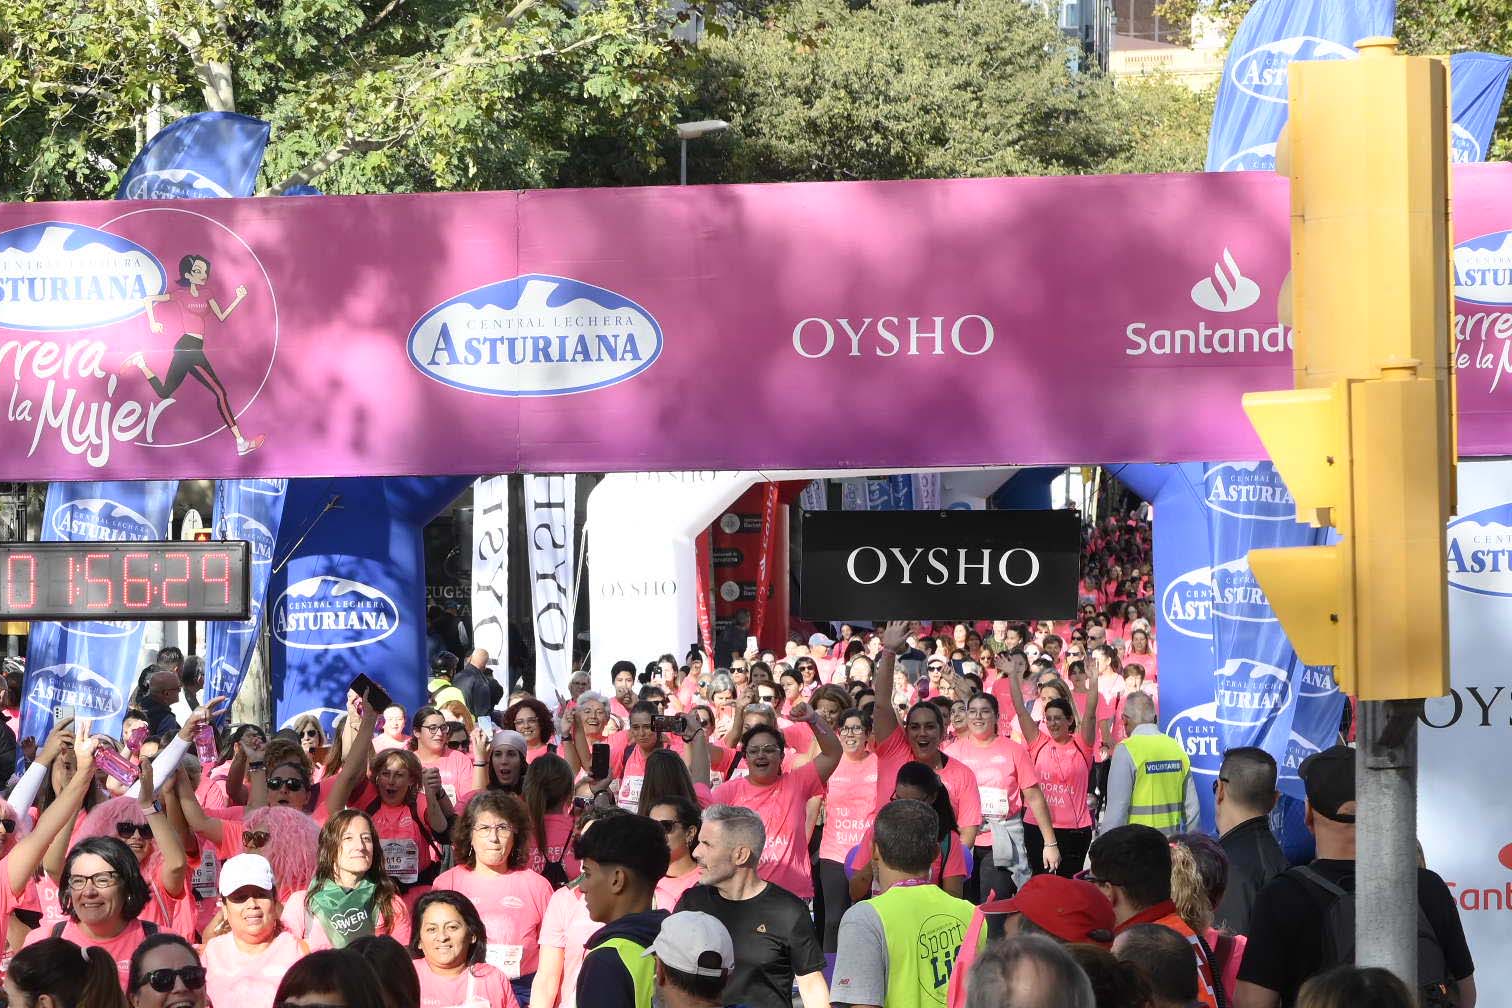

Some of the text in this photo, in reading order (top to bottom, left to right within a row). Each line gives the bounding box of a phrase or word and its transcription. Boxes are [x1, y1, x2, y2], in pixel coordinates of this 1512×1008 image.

[466, 316, 634, 329] CENTRAL LECHERA
[793, 314, 995, 359] OYSHO
[427, 322, 642, 366] ASTURIANA
[8, 383, 32, 422] la
[27, 374, 176, 468] Mujer
[846, 546, 1041, 586] OYSHO
[277, 605, 389, 633] ASTURIANA
[289, 601, 330, 609] CENTRAL
[1040, 783, 1075, 794] DORSAL
[835, 819, 874, 829] DORSA
[836, 808, 848, 816] TU
[919, 922, 964, 960] Sport
